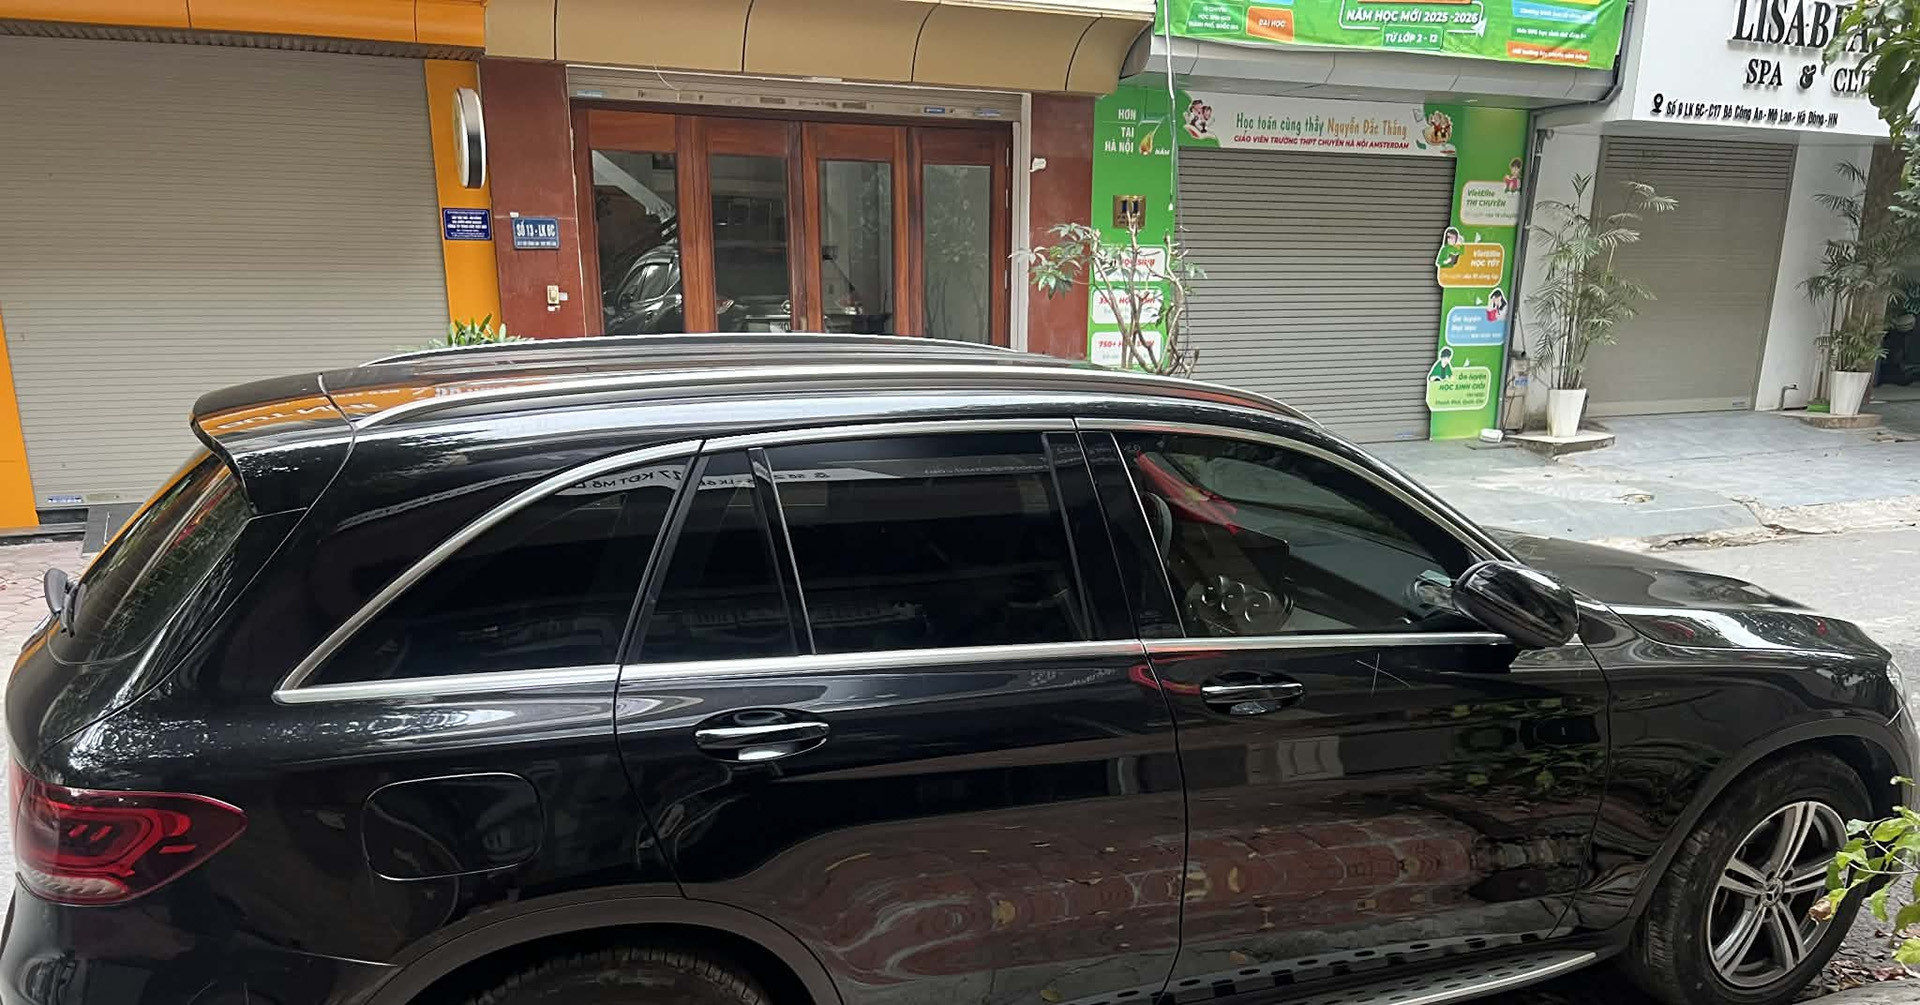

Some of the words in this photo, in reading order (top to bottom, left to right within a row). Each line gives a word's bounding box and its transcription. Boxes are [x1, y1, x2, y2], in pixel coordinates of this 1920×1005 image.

[1346, 7, 1372, 22] NĂM
[1374, 10, 1399, 25] HỌC
[1400, 9, 1422, 22] MỚI
[1423, 11, 1449, 23] 2025
[1385, 31, 1397, 41] TỪ
[1398, 32, 1415, 42] LỚP
[1745, 58, 1783, 86] SPA
[1799, 64, 1817, 90] &
[1118, 109, 1136, 121] HƠN
[1667, 99, 1679, 115] Số
[1684, 103, 1695, 117] LK
[1236, 112, 1254, 133] Học
[1257, 115, 1277, 130] toán
[1280, 116, 1301, 136] cùng
[1305, 115, 1324, 137] thầy
[1327, 117, 1360, 138] Nguyễn
[1363, 117, 1379, 135] Đắc
[1382, 119, 1407, 140] Thắng
[1104, 139, 1117, 152] HÀ
[1118, 139, 1135, 155] NỘI
[1233, 133, 1252, 142] GIÁO
[1252, 134, 1270, 144] VIÊN
[1270, 135, 1298, 145] TRƯỜNG
[1299, 138, 1317, 146] THPT
[1317, 137, 1344, 147] CHUYÊN
[1344, 139, 1355, 147] HÀ
[1356, 140, 1368, 148] NỘI
[1368, 141, 1410, 149] AMSTERDAM
[516, 219, 526, 237] SỐ
[526, 224, 534, 237] 13
[538, 224, 547, 237] LK
